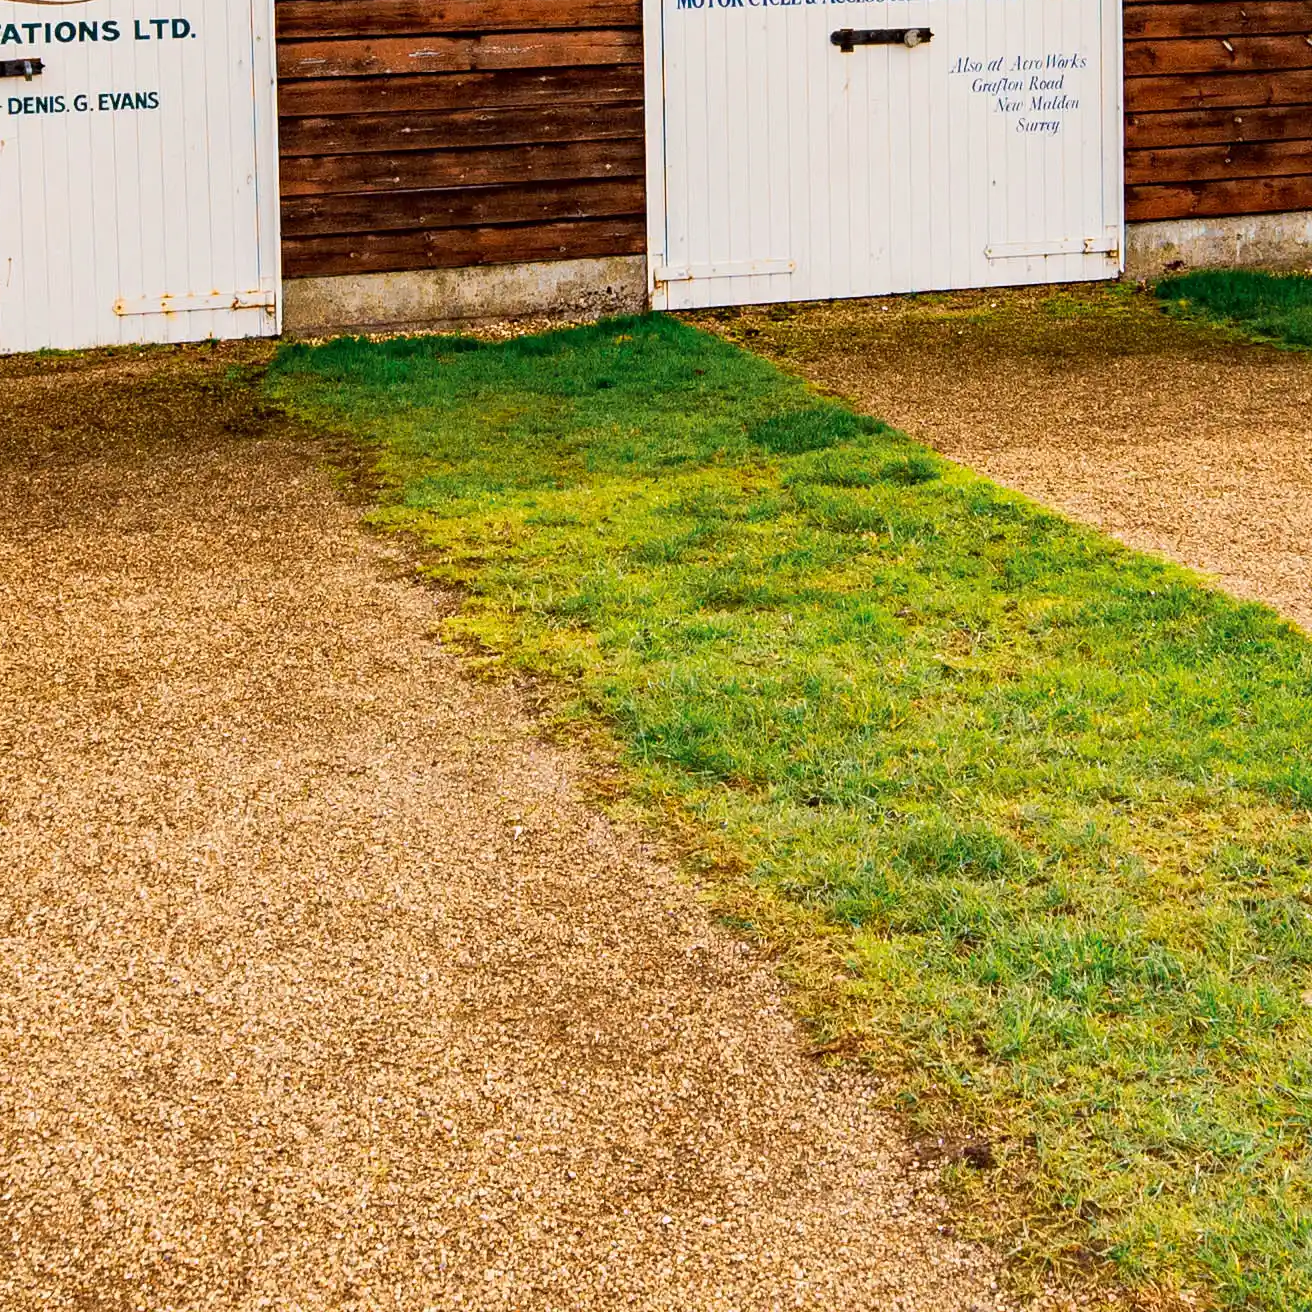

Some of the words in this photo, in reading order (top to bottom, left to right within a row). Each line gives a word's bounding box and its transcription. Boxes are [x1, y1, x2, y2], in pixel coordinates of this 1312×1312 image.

[133, 18, 196, 41] LTD.
[948, 57, 983, 74] Also
[987, 56, 1004, 72] at
[971, 77, 1023, 95] Grafton
[1028, 74, 1065, 91] Road
[73, 94, 94, 112] G.
[98, 91, 160, 111] EVANS
[995, 97, 1023, 113] New
[1030, 94, 1080, 112] Malden
[1015, 118, 1061, 136] Surrey
